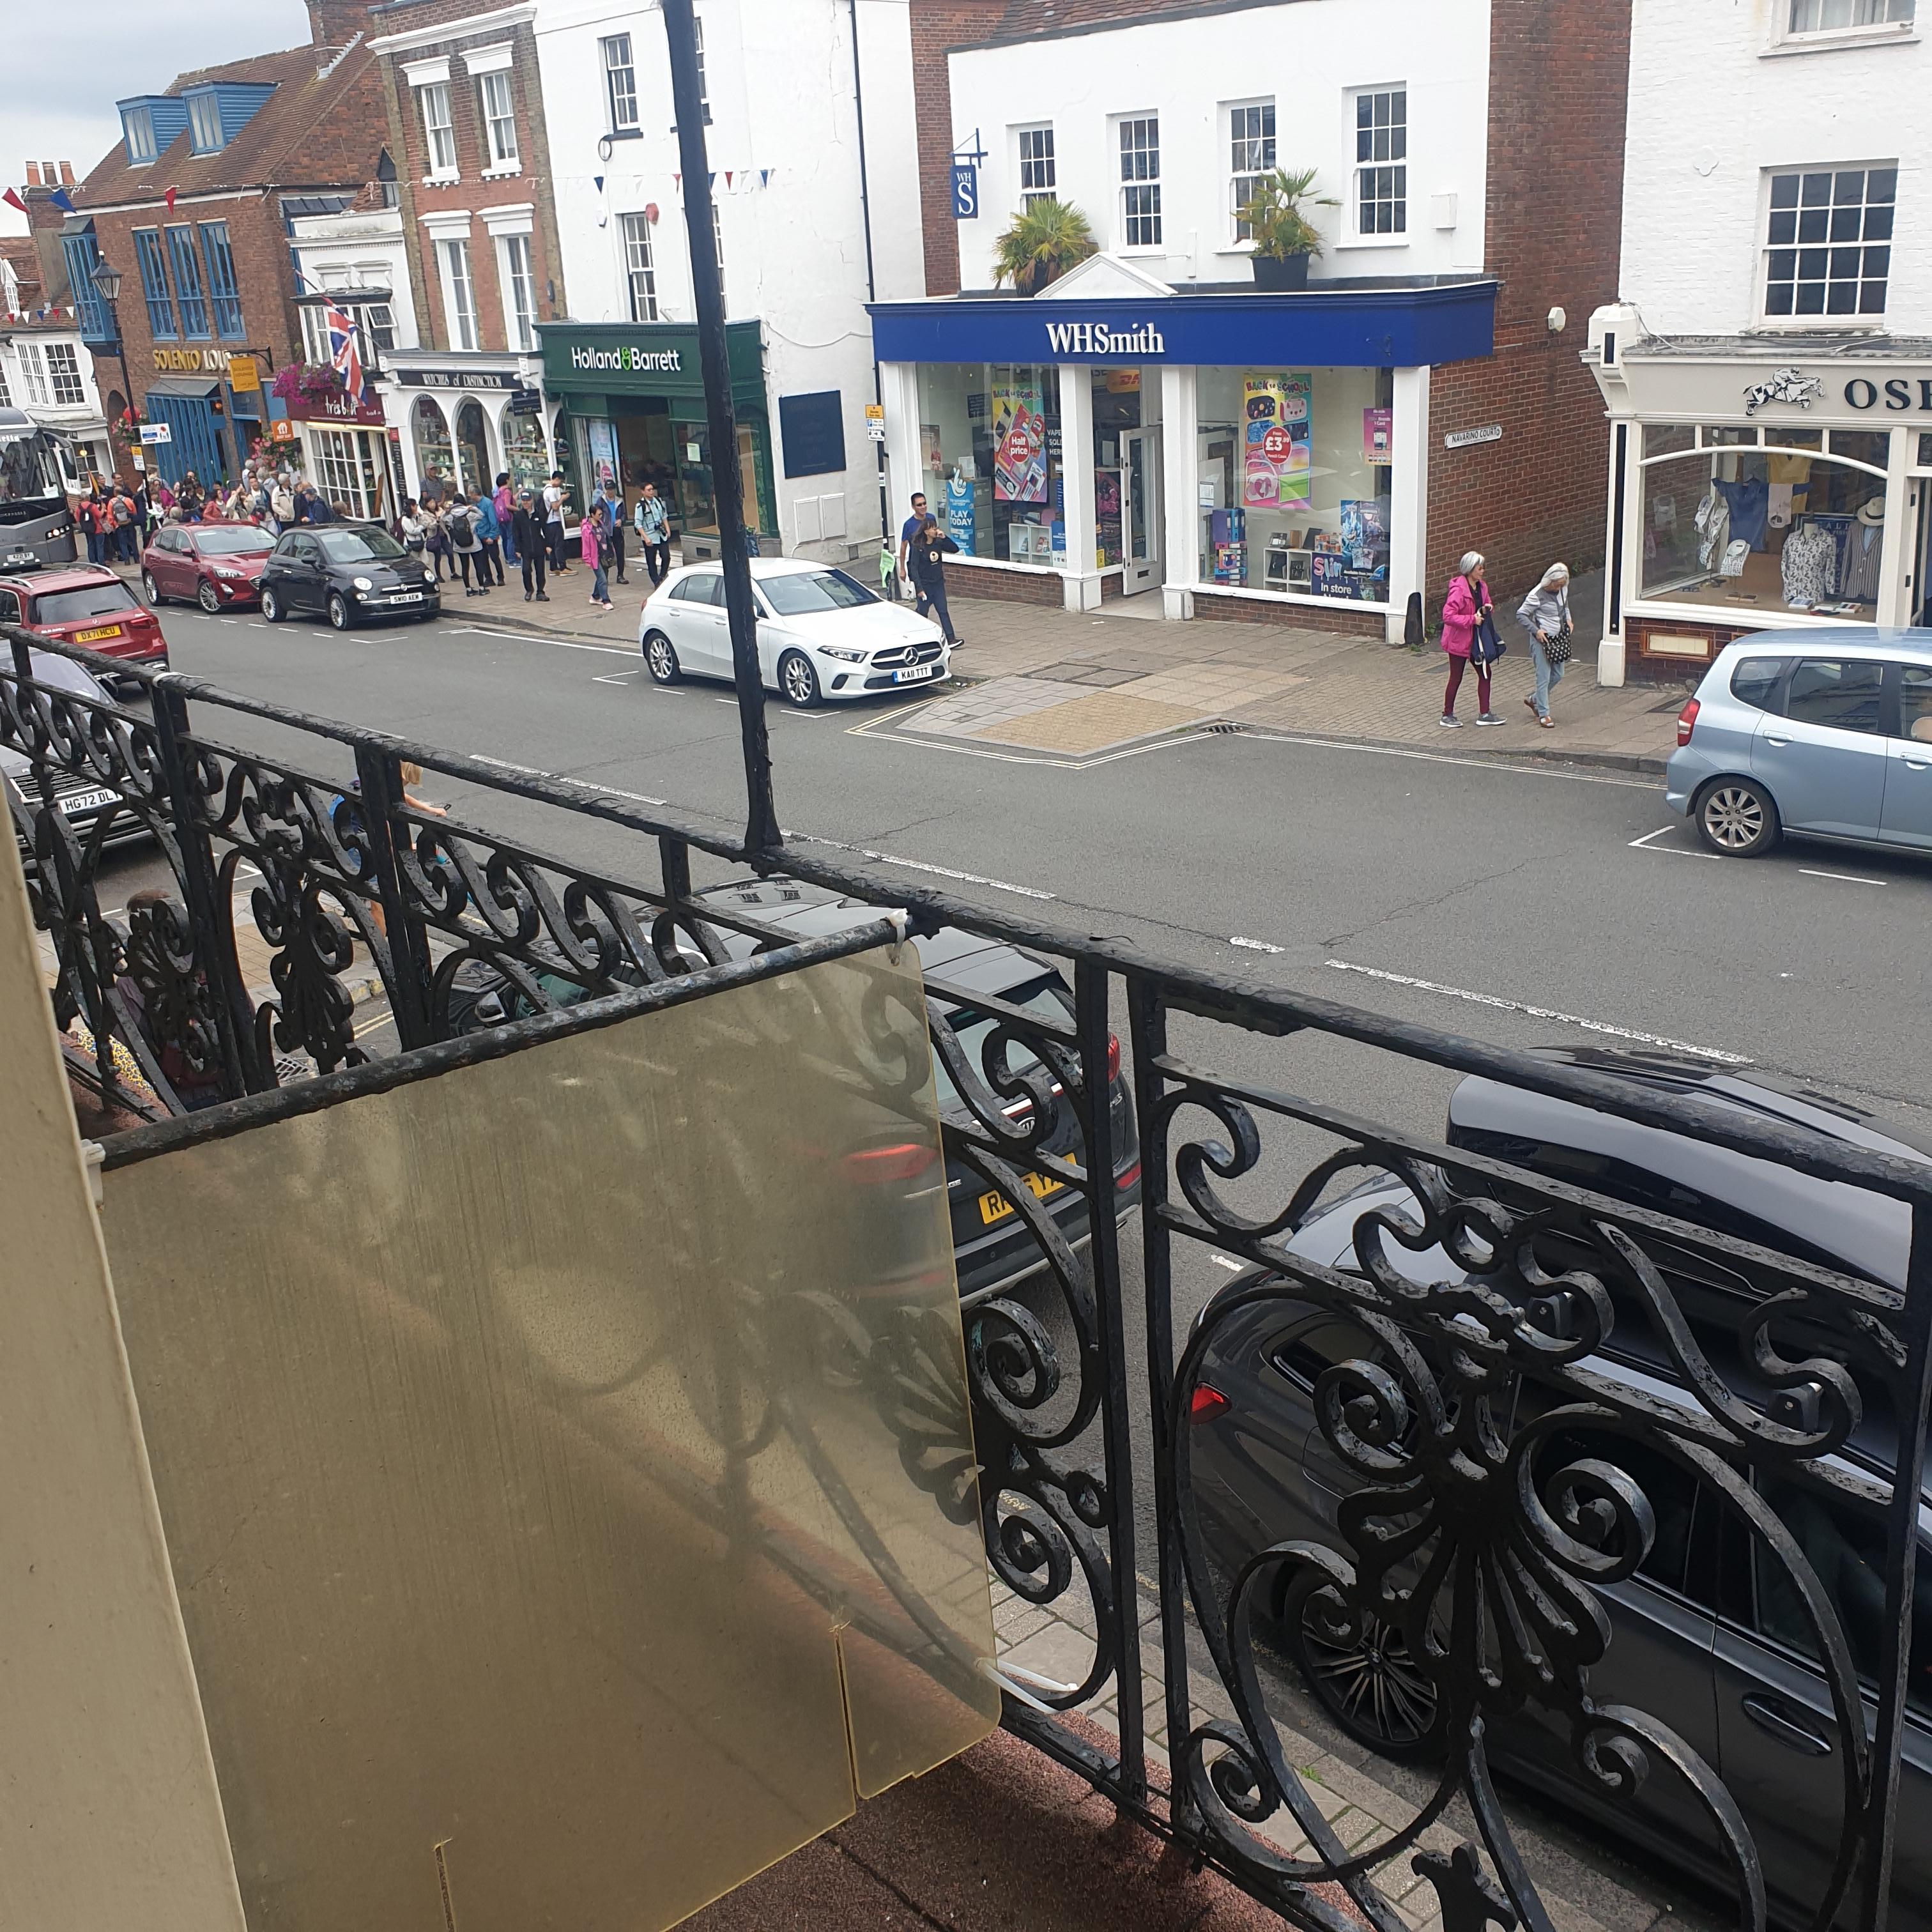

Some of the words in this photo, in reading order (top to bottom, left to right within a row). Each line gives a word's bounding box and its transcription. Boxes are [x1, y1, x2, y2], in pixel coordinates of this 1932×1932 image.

[1045, 322, 1165, 355] WHSmith
[153, 349, 201, 370] SOLENTO
[463, 374, 502, 388] DISTINCTION
[1011, 436, 1026, 445] Half
[1452, 431, 1478, 443] NAVARINO
[1480, 427, 1497, 438] COURT
[1010, 446, 1028, 456] price
[951, 509, 968, 518] PLAY
[949, 517, 972, 526] TODAY
[1321, 582, 1328, 592] In
[1330, 584, 1352, 594] store
[82, 631, 99, 640] DX71
[100, 627, 116, 636] HCU
[916, 667, 928, 677] TTT
[65, 795, 96, 811] HG72
